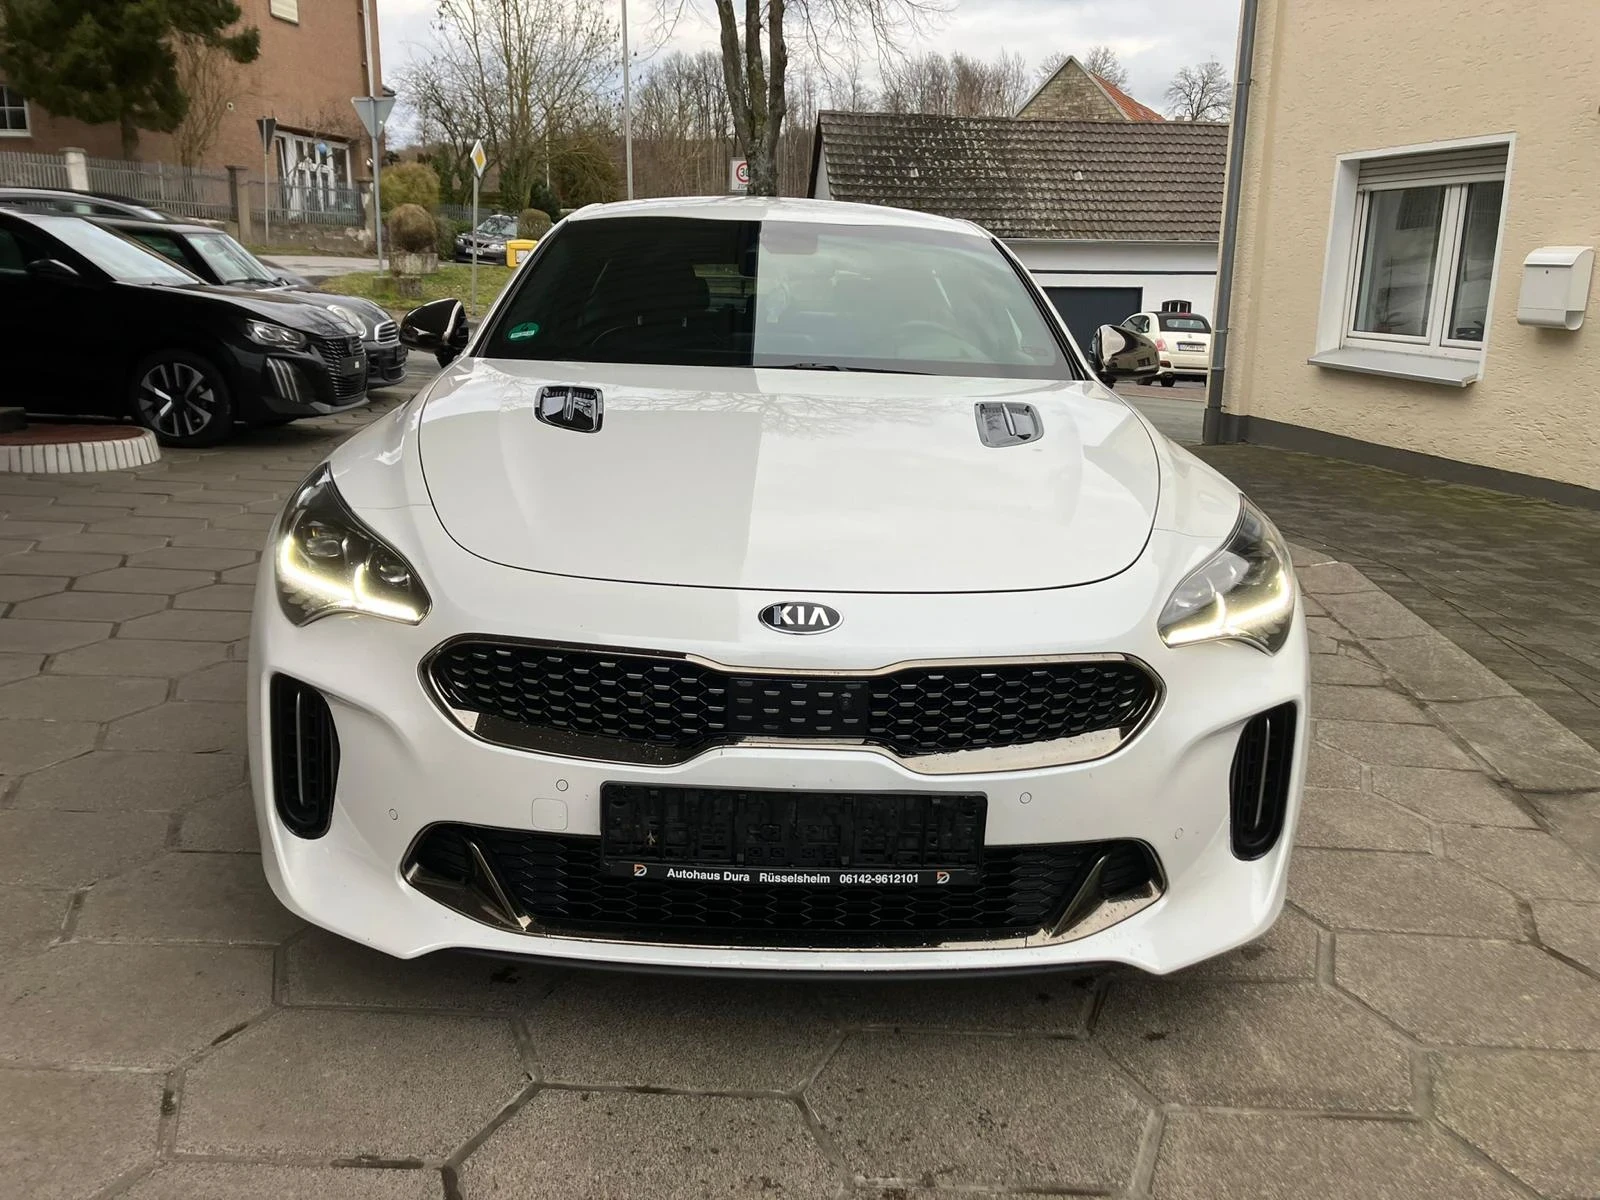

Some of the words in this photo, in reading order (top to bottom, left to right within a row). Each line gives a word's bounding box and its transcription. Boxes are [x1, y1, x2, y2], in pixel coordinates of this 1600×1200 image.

[773, 605, 831, 626] KIA
[666, 868, 720, 880] Autohaus
[723, 871, 750, 882] Dura
[759, 872, 831, 884] Rüsselsheim
[839, 873, 919, 884] 06142-9612101
